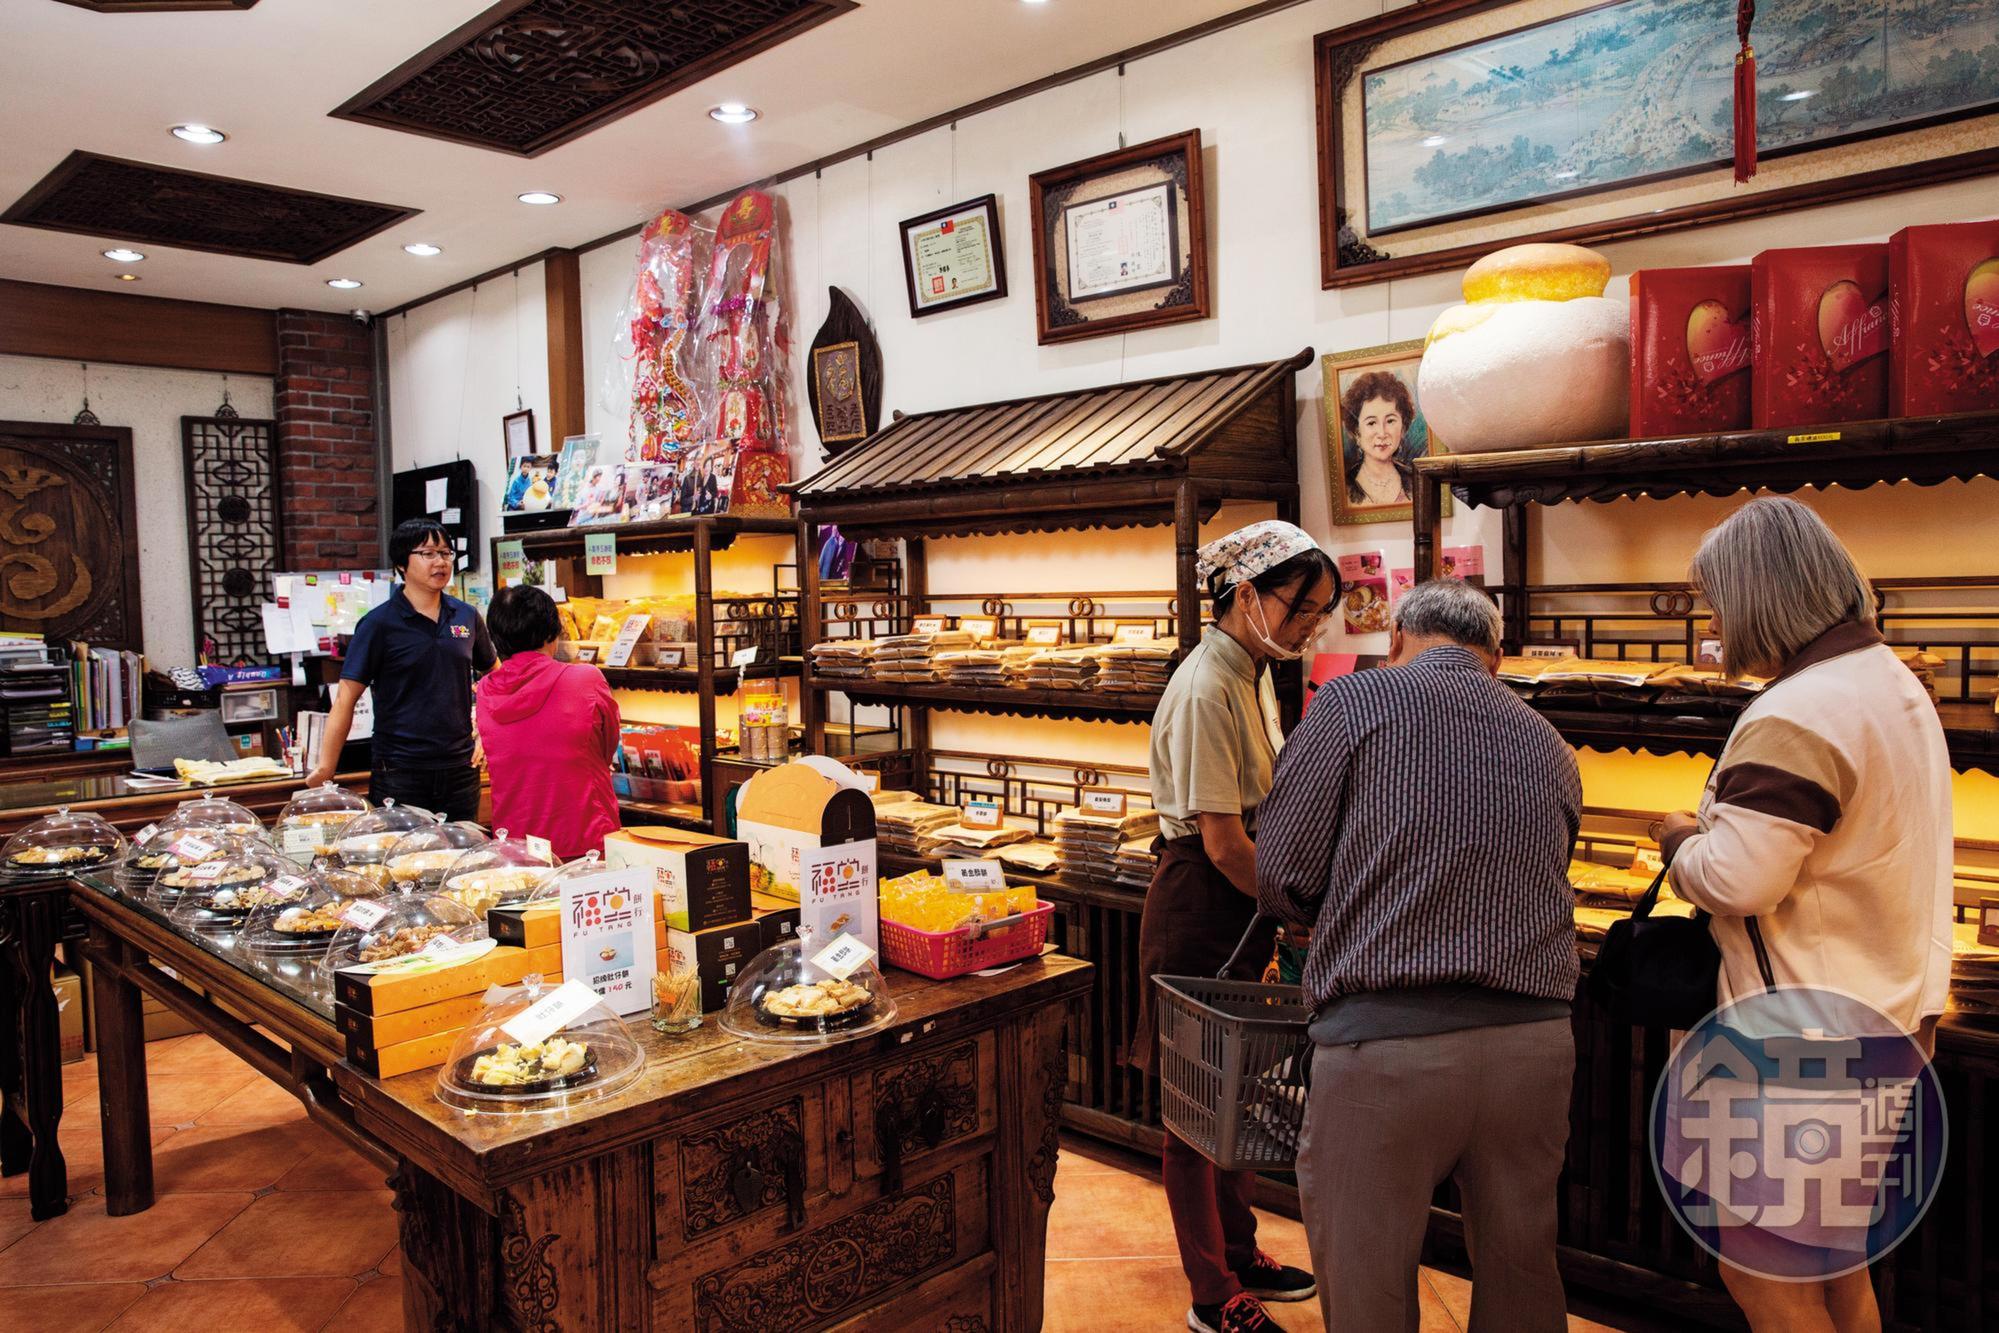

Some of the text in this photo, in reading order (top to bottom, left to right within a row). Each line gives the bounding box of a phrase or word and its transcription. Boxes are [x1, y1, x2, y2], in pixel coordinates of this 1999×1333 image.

[573, 921, 633, 938] FU TANG
[624, 981, 633, 990] 元
